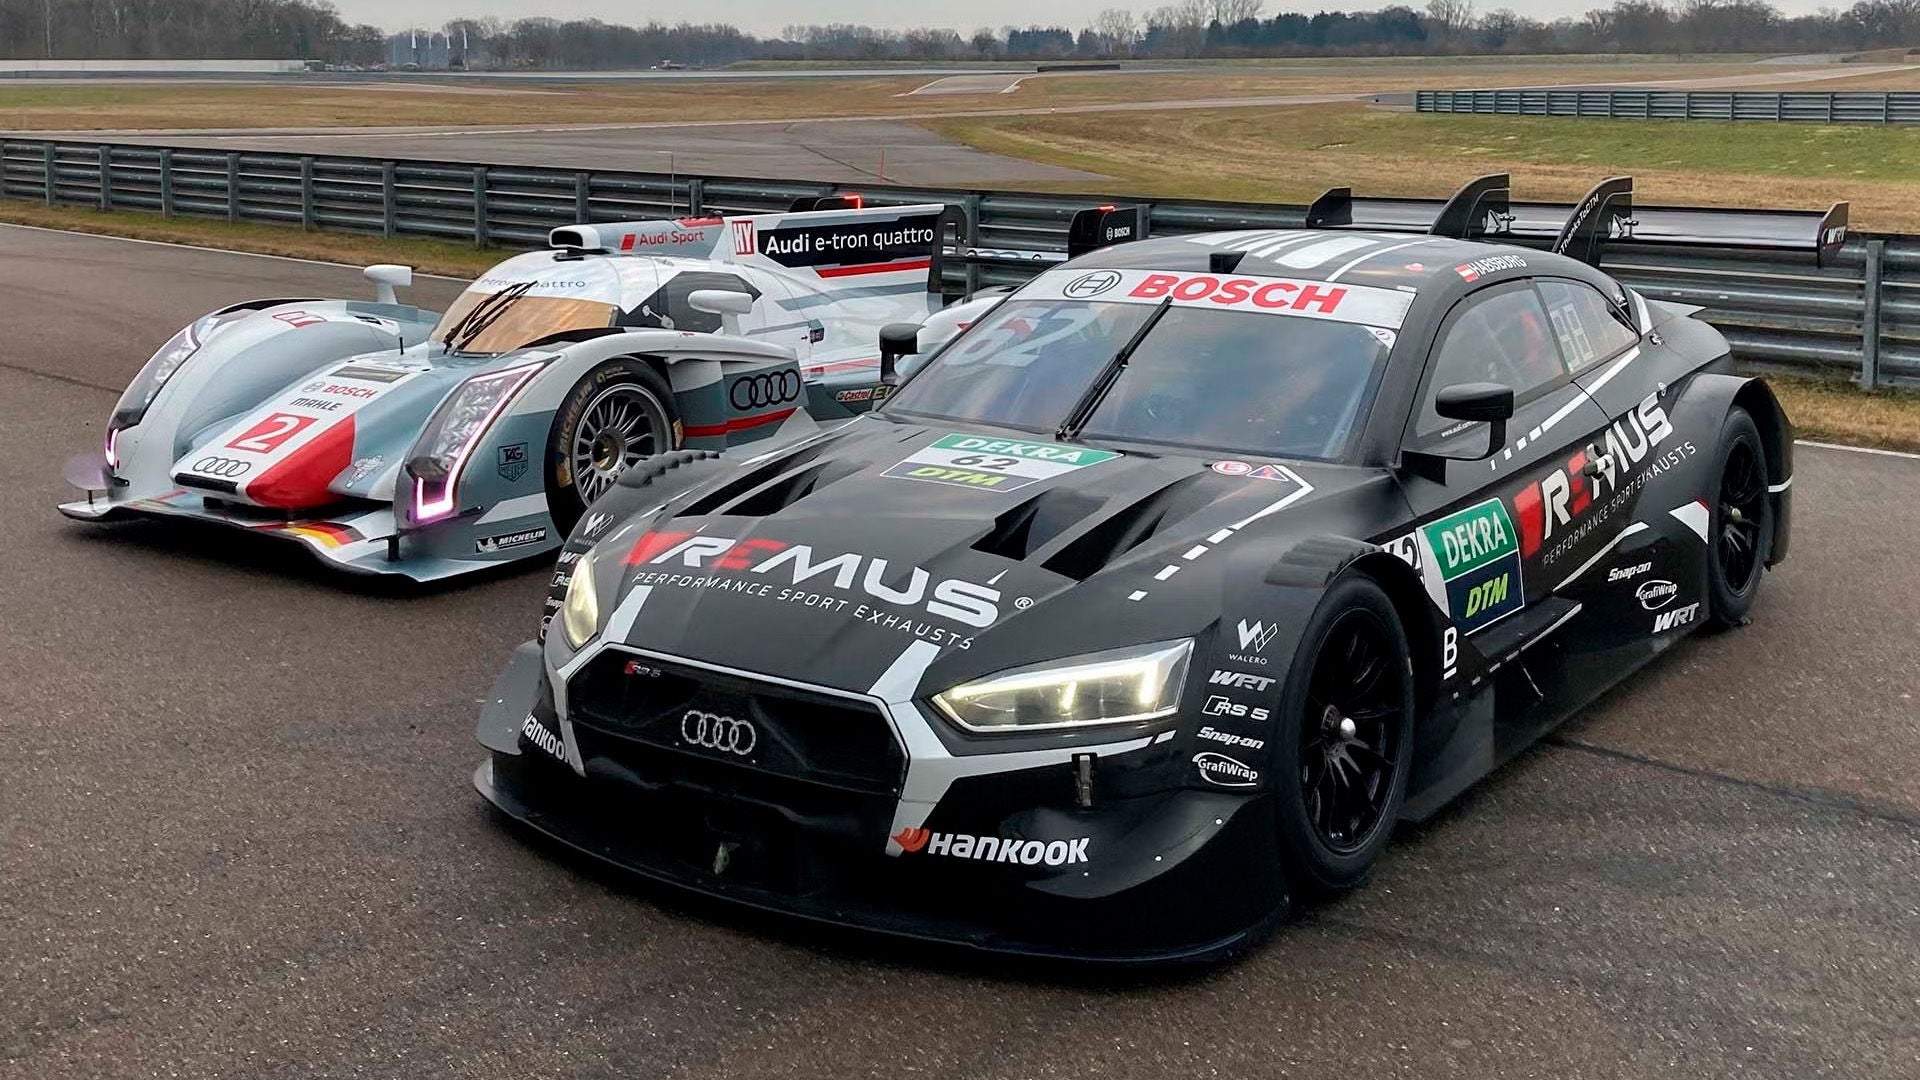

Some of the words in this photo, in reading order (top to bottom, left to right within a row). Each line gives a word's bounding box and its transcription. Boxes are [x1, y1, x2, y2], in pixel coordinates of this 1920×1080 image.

[1114, 226, 1131, 238] BOSCH
[1558, 192, 1599, 255] ThanksToDTM
[639, 233, 668, 246] Audi
[671, 231, 705, 244] Sport
[732, 221, 754, 255] HY
[766, 233, 809, 255] Audi
[815, 233, 868, 251] e-tron
[873, 227, 934, 250] quattro
[1470, 254, 1528, 276] HABSBURG
[1128, 273, 1348, 314] BOSCH
[943, 307, 1098, 368] 62
[323, 384, 379, 399] BOSCH
[290, 397, 343, 412] MAHLE
[234, 413, 301, 450] 2
[502, 446, 524, 462] TAG
[951, 438, 1084, 464] DEKRA
[951, 455, 1020, 470] 62
[905, 467, 1008, 486] DTM
[1541, 392, 1674, 541] REMUS
[1542, 507, 1610, 568] PERFORMANCE
[1611, 480, 1636, 514] SPORT
[1636, 441, 1697, 490] EXHAUSTS
[498, 530, 546, 545] MICHELIN
[1441, 511, 1508, 569] DEKRA
[649, 536, 1001, 628] REMUS
[1607, 562, 1652, 582] Snap-on
[1465, 572, 1509, 619] DTM
[1639, 583, 1678, 601] GrafiWrap
[632, 572, 773, 597] PERFORMANCE
[777, 588, 849, 612] SPORT
[853, 605, 975, 650] EXHAUSTS
[1651, 602, 1700, 634] WRT
[1229, 653, 1268, 666] WALERO
[1443, 626, 1458, 670] B
[1208, 669, 1277, 692] WRT
[1214, 701, 1248, 717] RS
[1250, 707, 1270, 721] 5
[1197, 726, 1264, 749] Snap-on
[1197, 758, 1259, 782] GrafiWrap
